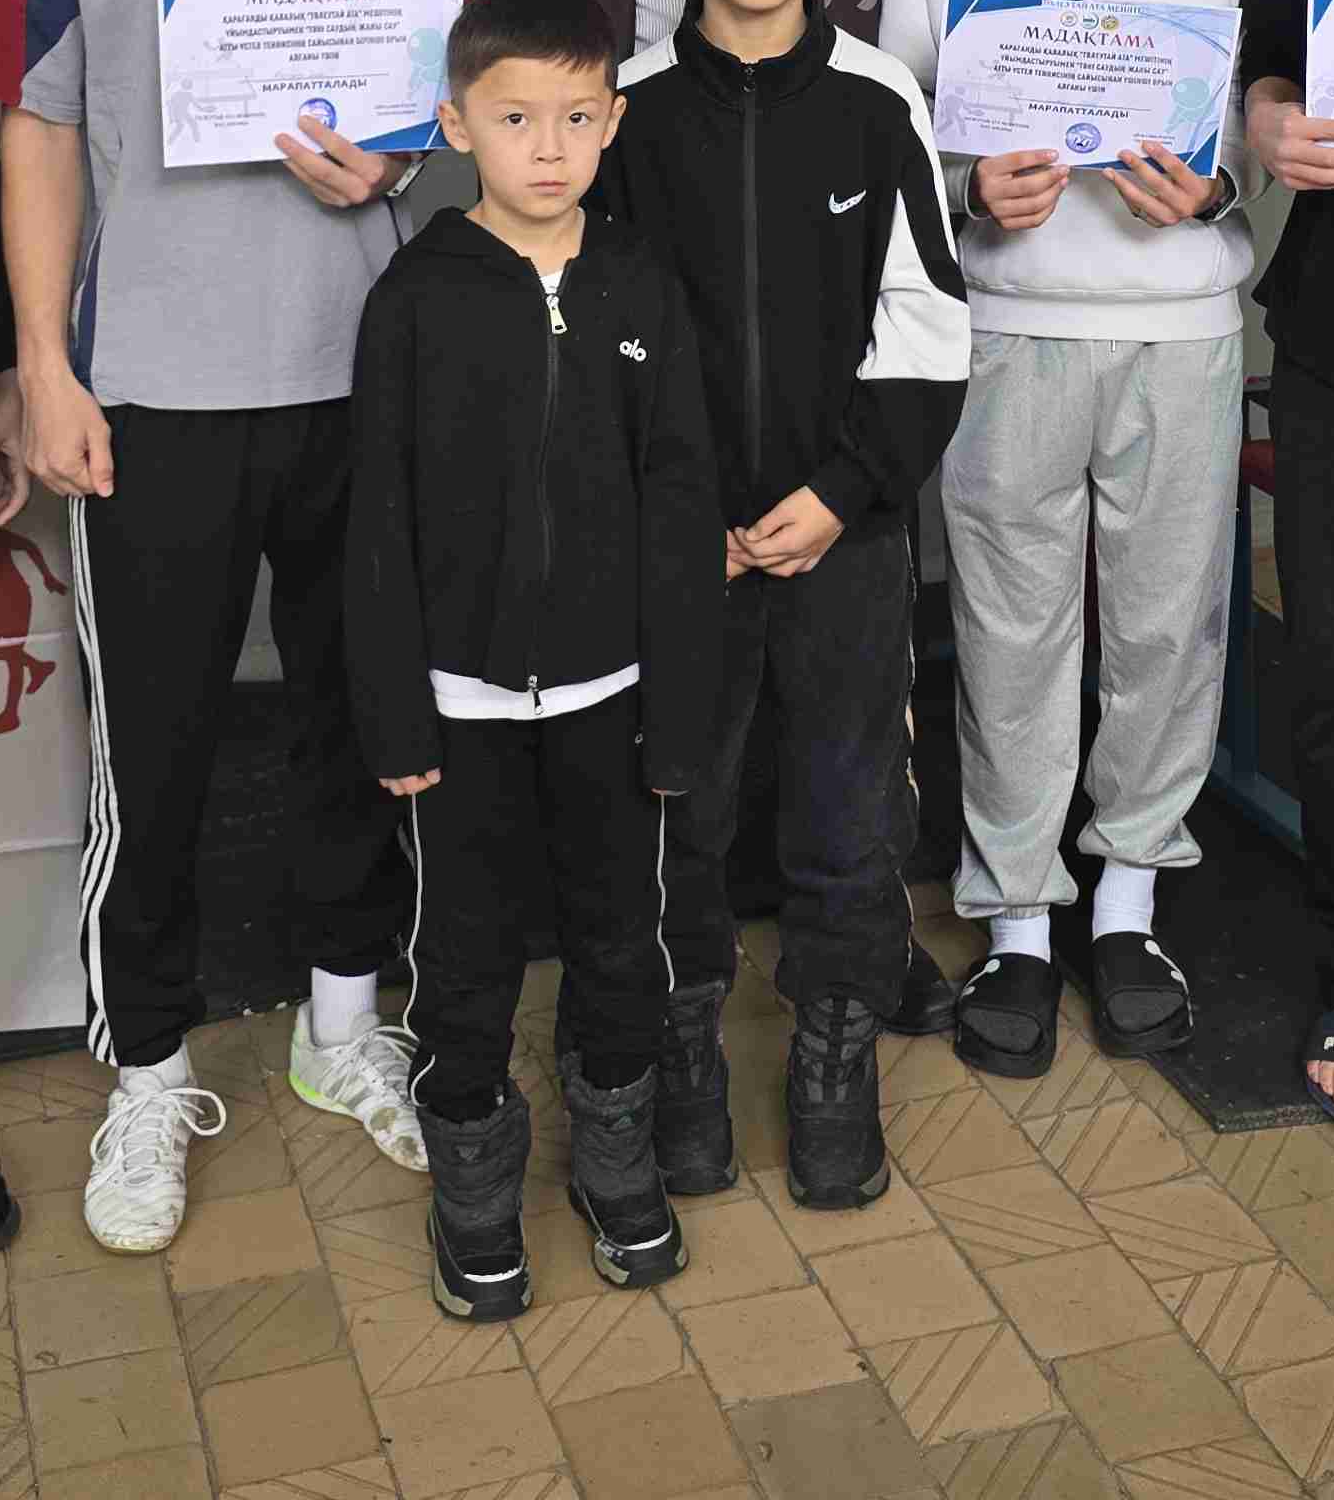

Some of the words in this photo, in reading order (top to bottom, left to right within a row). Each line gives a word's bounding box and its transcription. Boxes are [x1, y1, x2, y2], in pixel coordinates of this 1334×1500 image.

[1023, 26, 1155, 49] МАДАҚТАМА
[262, 79, 367, 92] МАРАПАТТАЛАДЫ
[1028, 103, 1129, 118] МАРАПАТТАЛАДЫ
